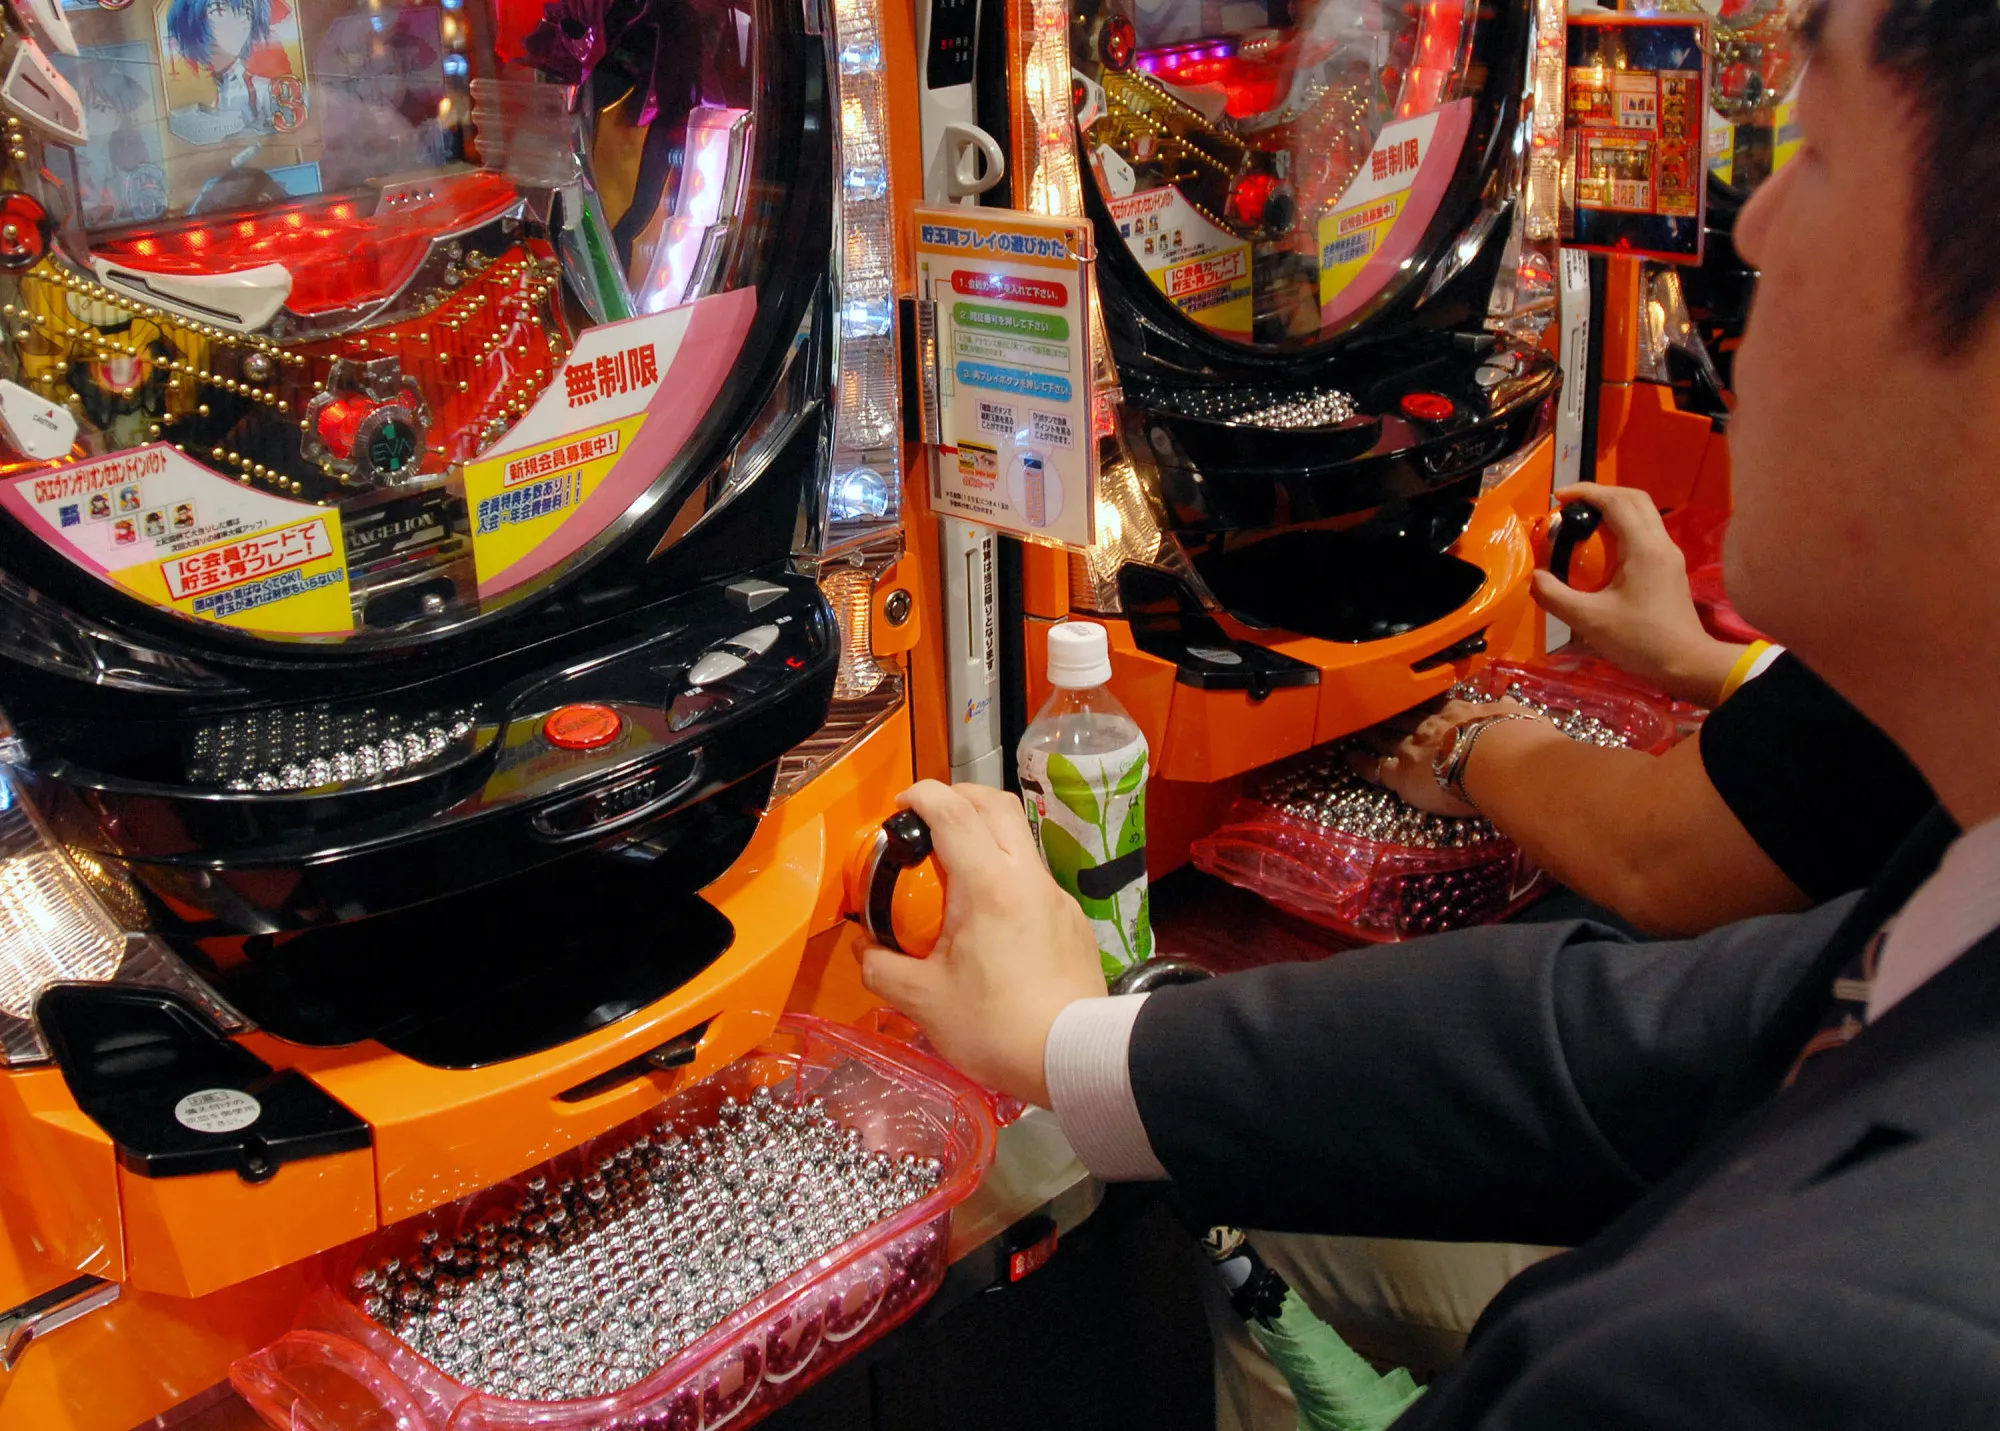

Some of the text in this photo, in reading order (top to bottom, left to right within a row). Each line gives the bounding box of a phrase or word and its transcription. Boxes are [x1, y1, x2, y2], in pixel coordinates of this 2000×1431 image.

[1372, 138, 1419, 182] 無制限
[922, 225, 1065, 258] 貯玉再プレイの遊びかた
[565, 343, 659, 408] 無制限
[510, 435, 613, 480] 新規会員募集中！
[179, 524, 316, 576] IC会員カードで
